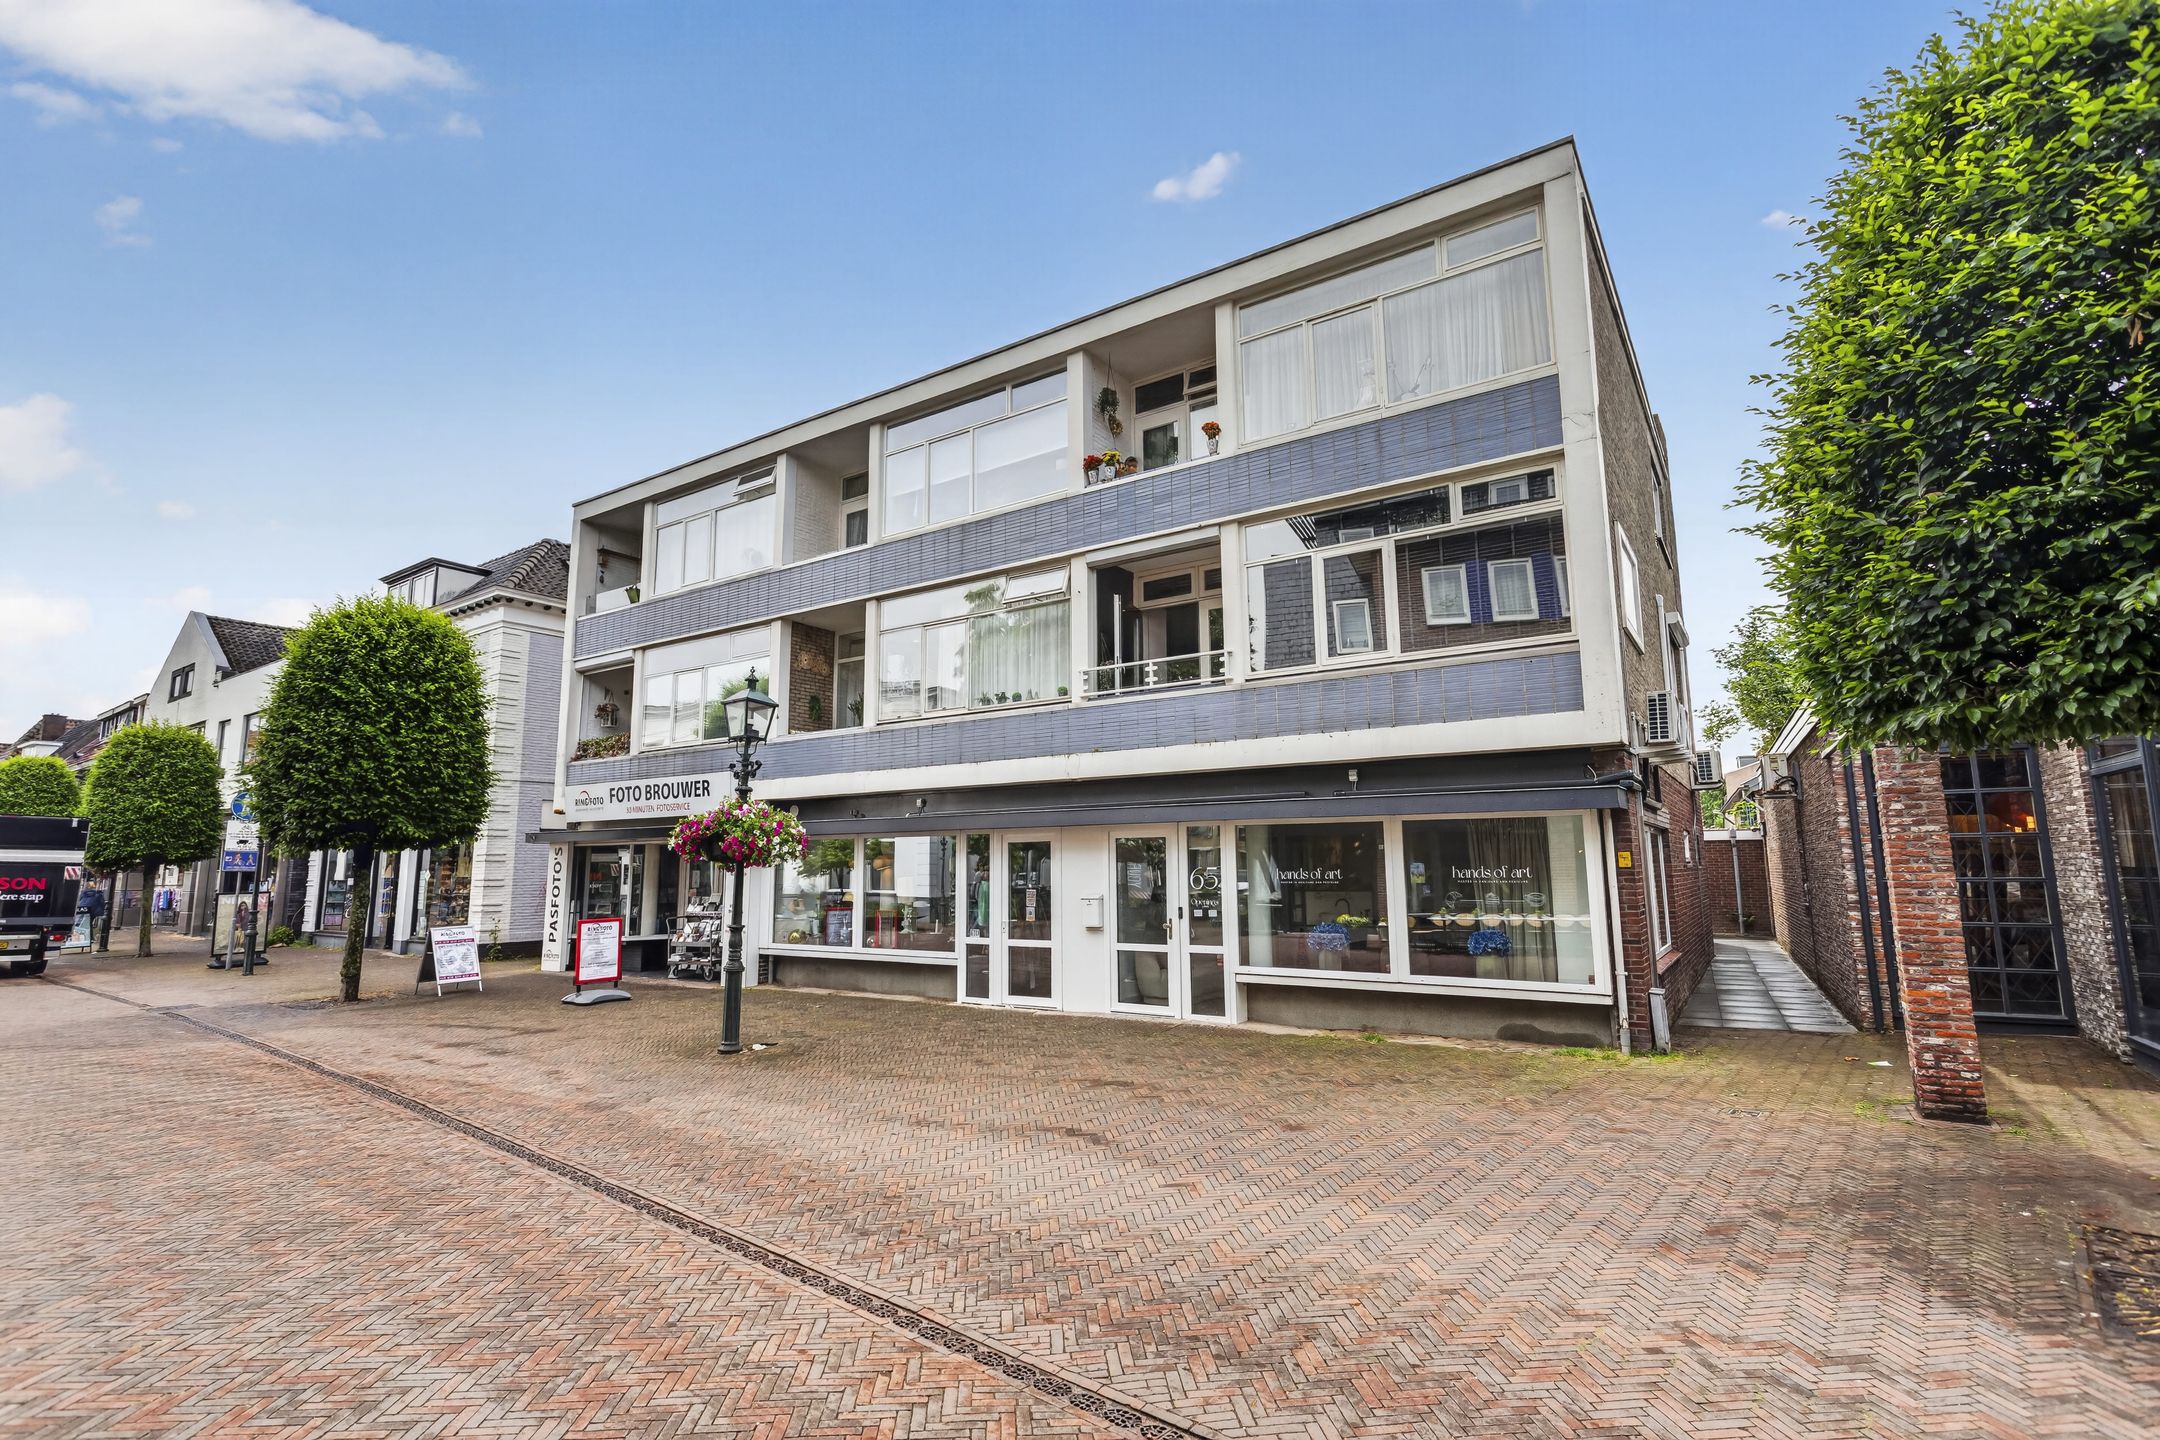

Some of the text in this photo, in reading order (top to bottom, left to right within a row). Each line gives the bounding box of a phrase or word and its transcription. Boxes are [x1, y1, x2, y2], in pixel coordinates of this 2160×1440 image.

[609, 780, 711, 804] FOTO BROUWER
[632, 804, 655, 813] MINUTEN
[656, 802, 691, 812] FOTOSERVICE
[1190, 866, 1218, 890] 65
[1276, 867, 1344, 880] hands of art
[1452, 865, 1533, 879] hands of art
[0, 891, 44, 903] ere stap
[548, 847, 563, 943] PASFOTO'S
